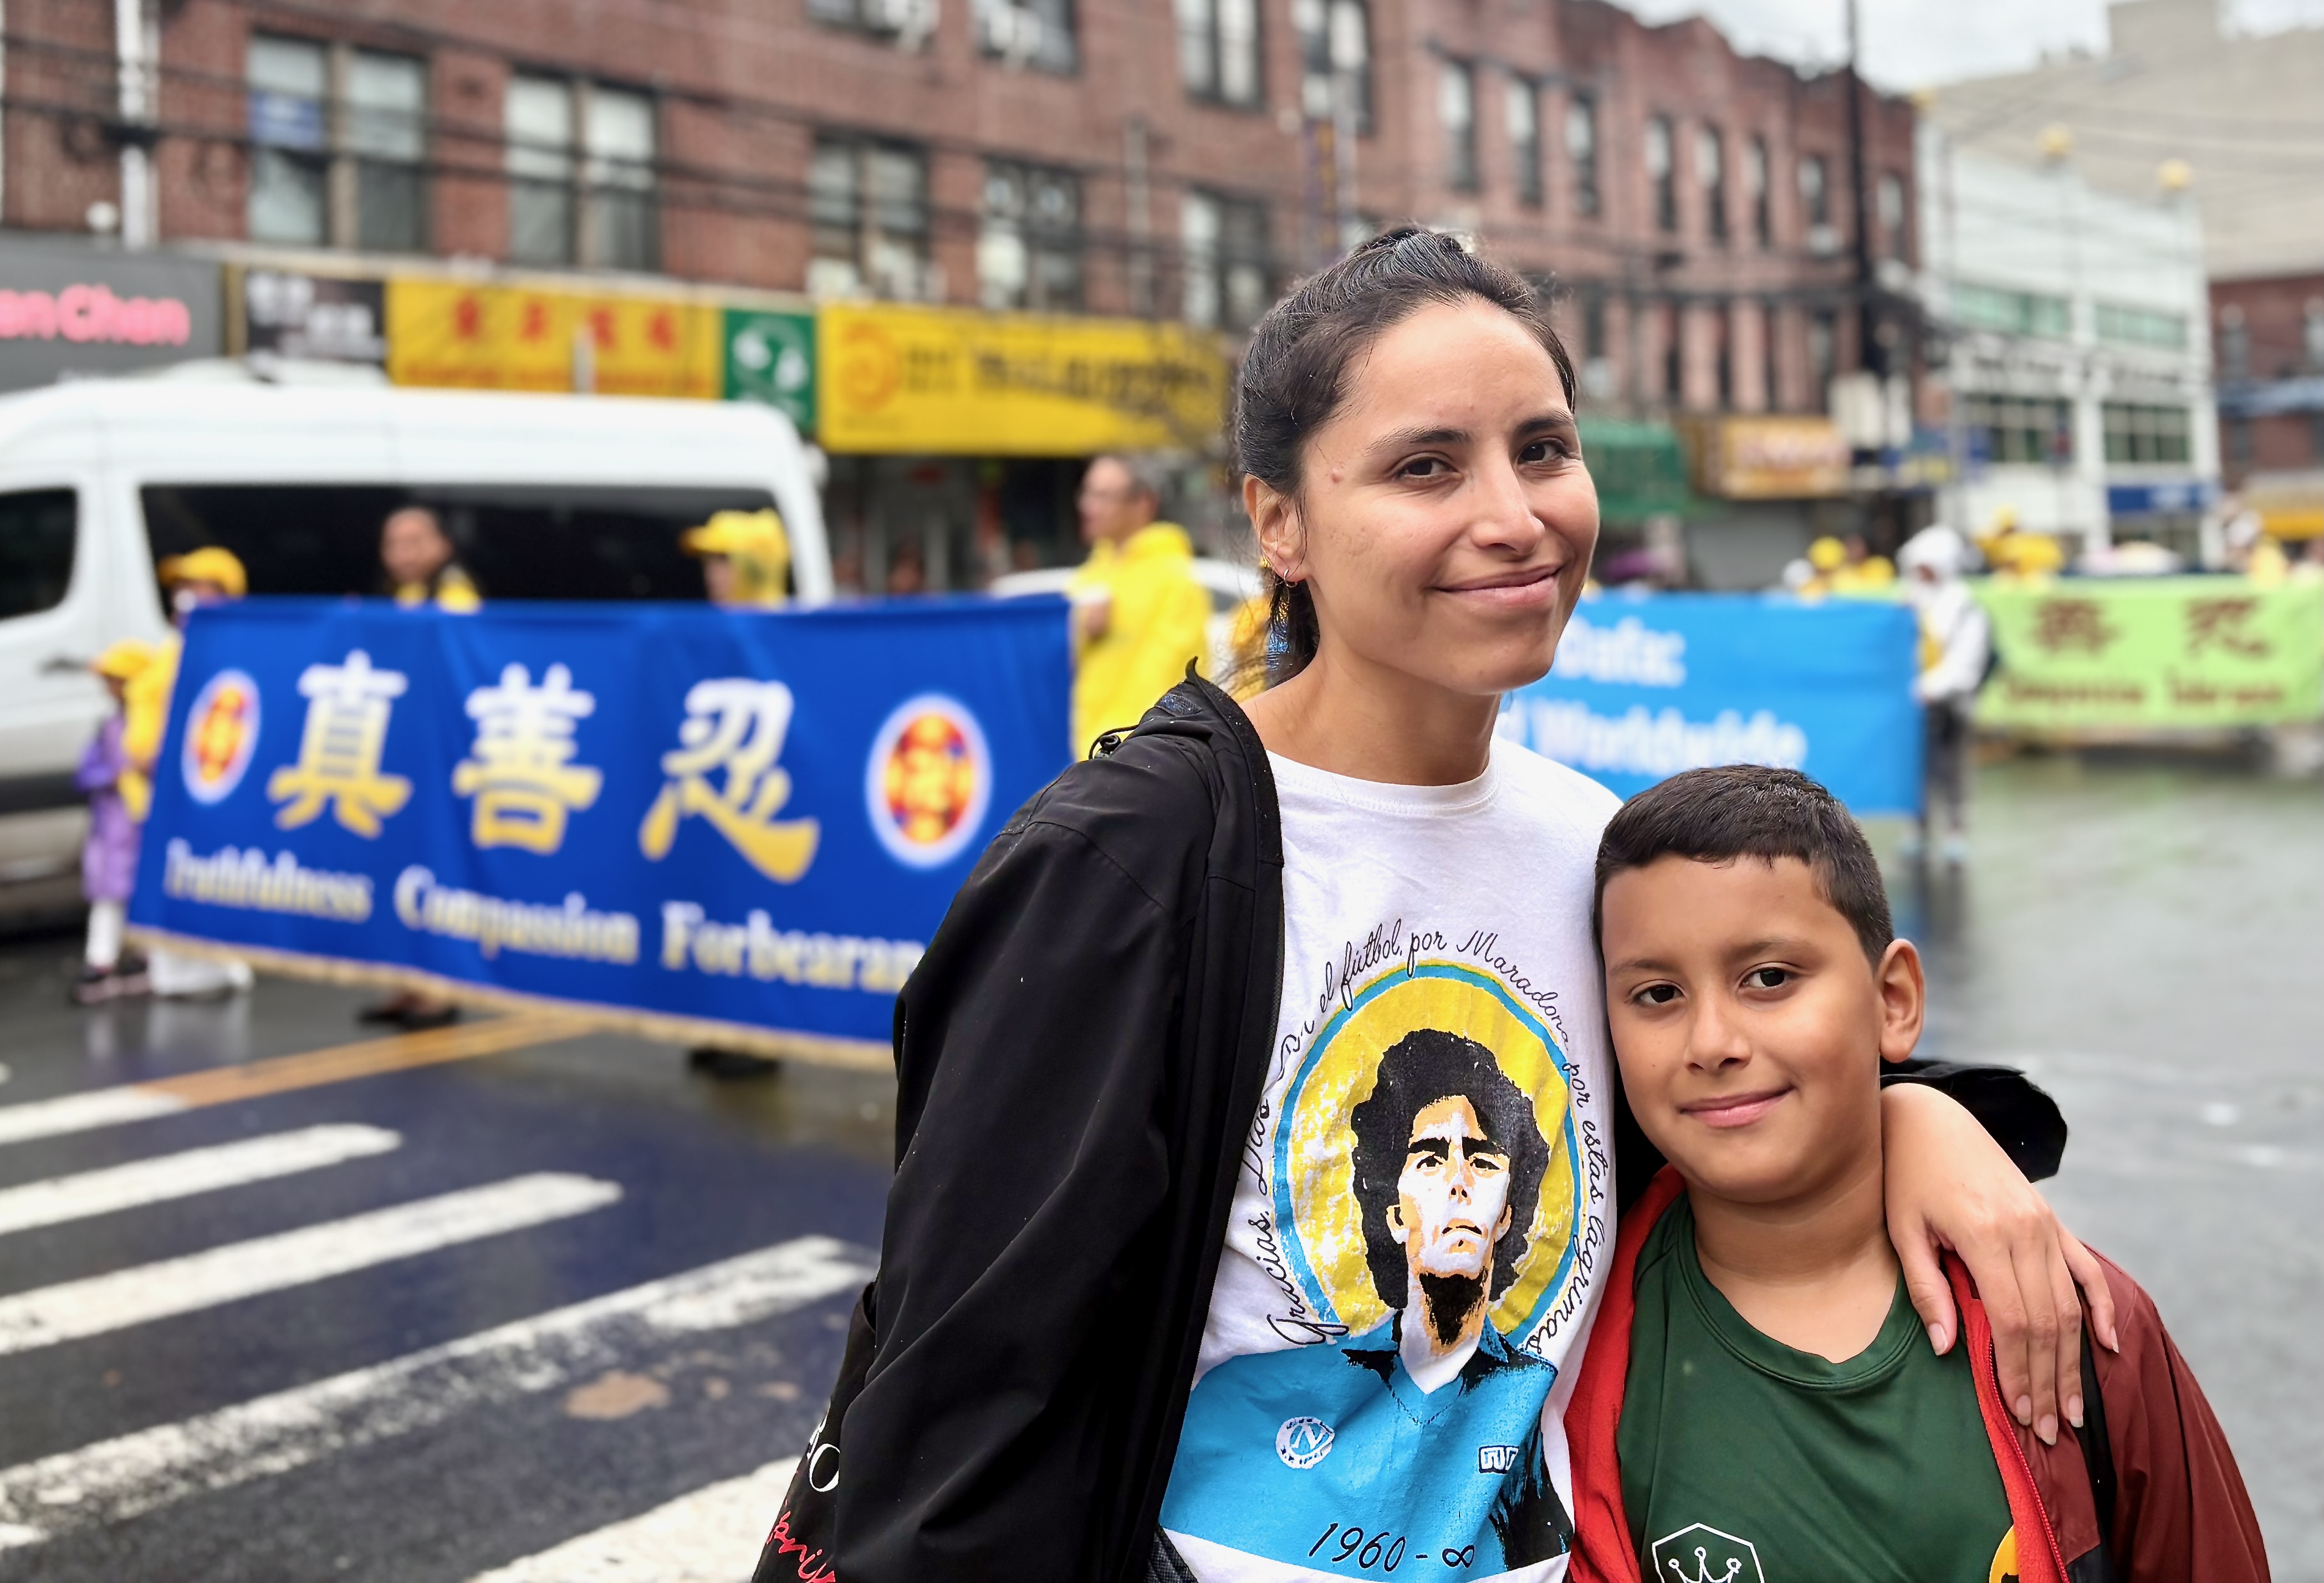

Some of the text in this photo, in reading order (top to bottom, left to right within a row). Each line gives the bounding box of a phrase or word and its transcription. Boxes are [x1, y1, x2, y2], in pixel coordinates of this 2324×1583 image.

[162, 837, 375, 925] Truthfulness
[394, 864, 642, 966] Compassion
[1320, 961, 1335, 1014] el
[1406, 930, 1448, 978] por
[1561, 1061, 1593, 1109] por
[1581, 1120, 1608, 1205] estas
